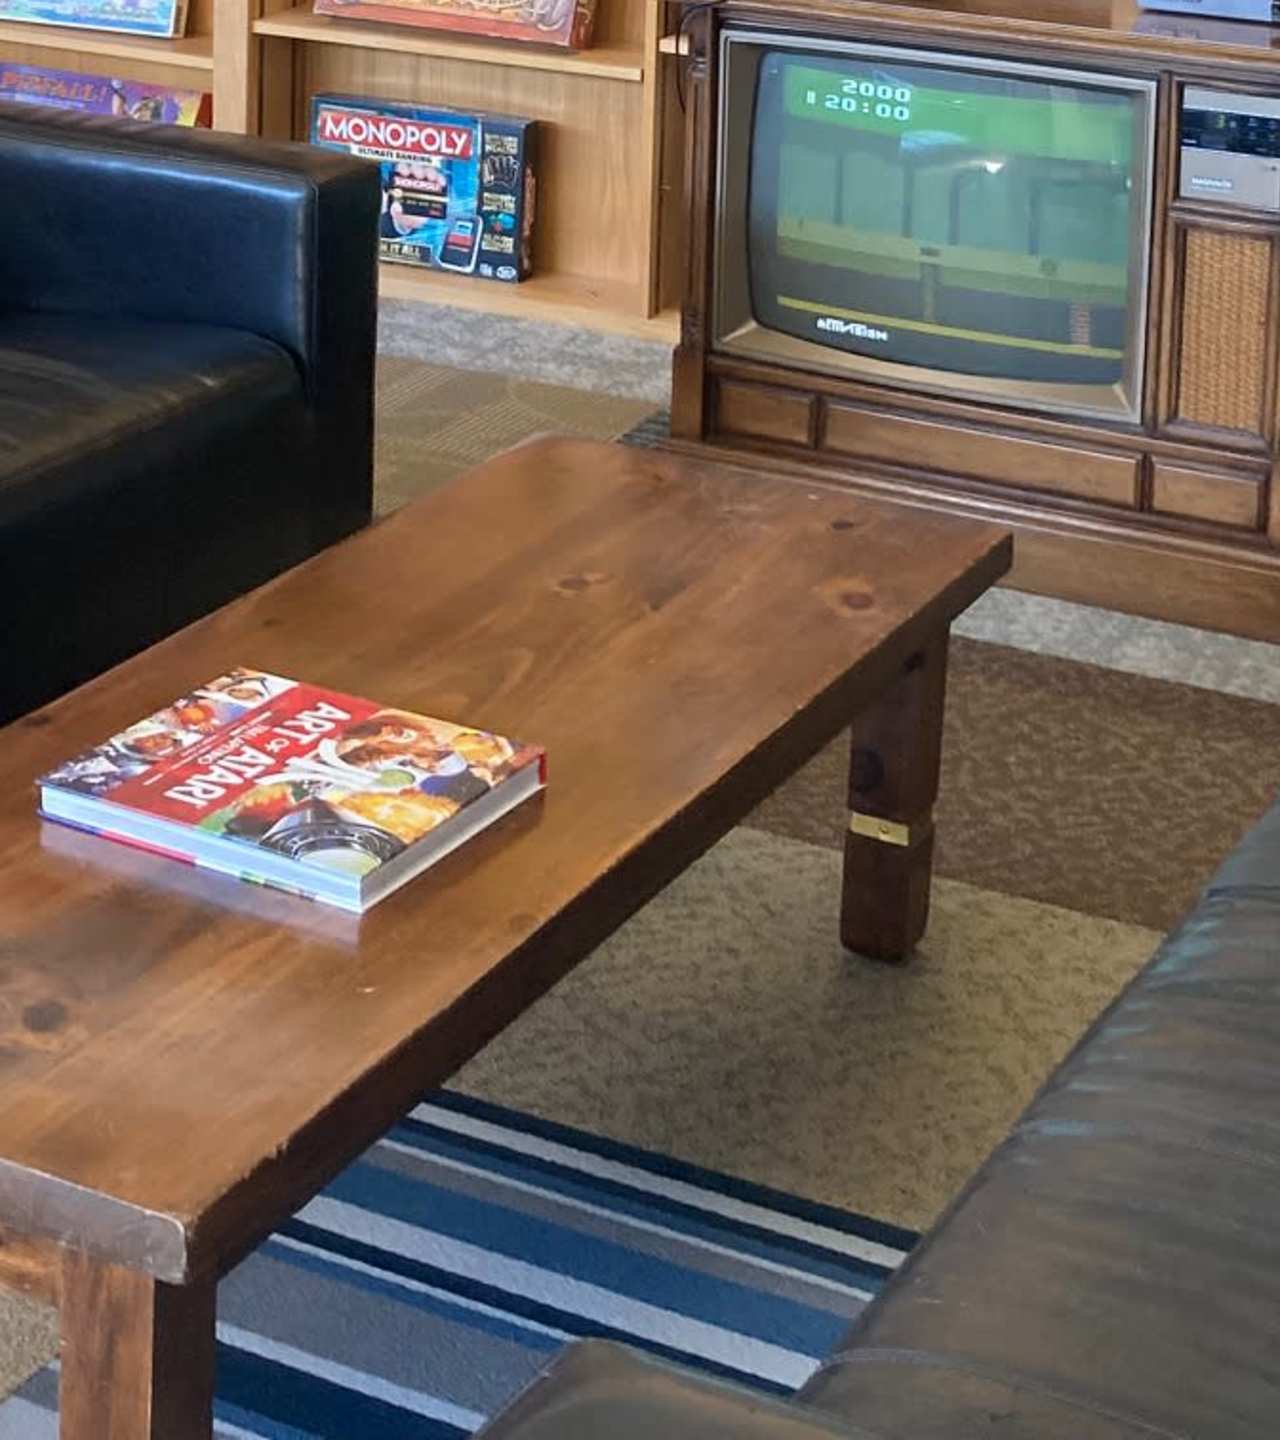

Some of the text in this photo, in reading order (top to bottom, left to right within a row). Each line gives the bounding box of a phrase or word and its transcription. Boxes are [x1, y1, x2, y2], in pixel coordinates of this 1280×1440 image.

[824, 94, 911, 121] 20:00
[842, 78, 912, 102] 2000
[322, 114, 473, 158] MONOPOLY
[272, 701, 352, 745] ART
[163, 746, 278, 809] ATARI
